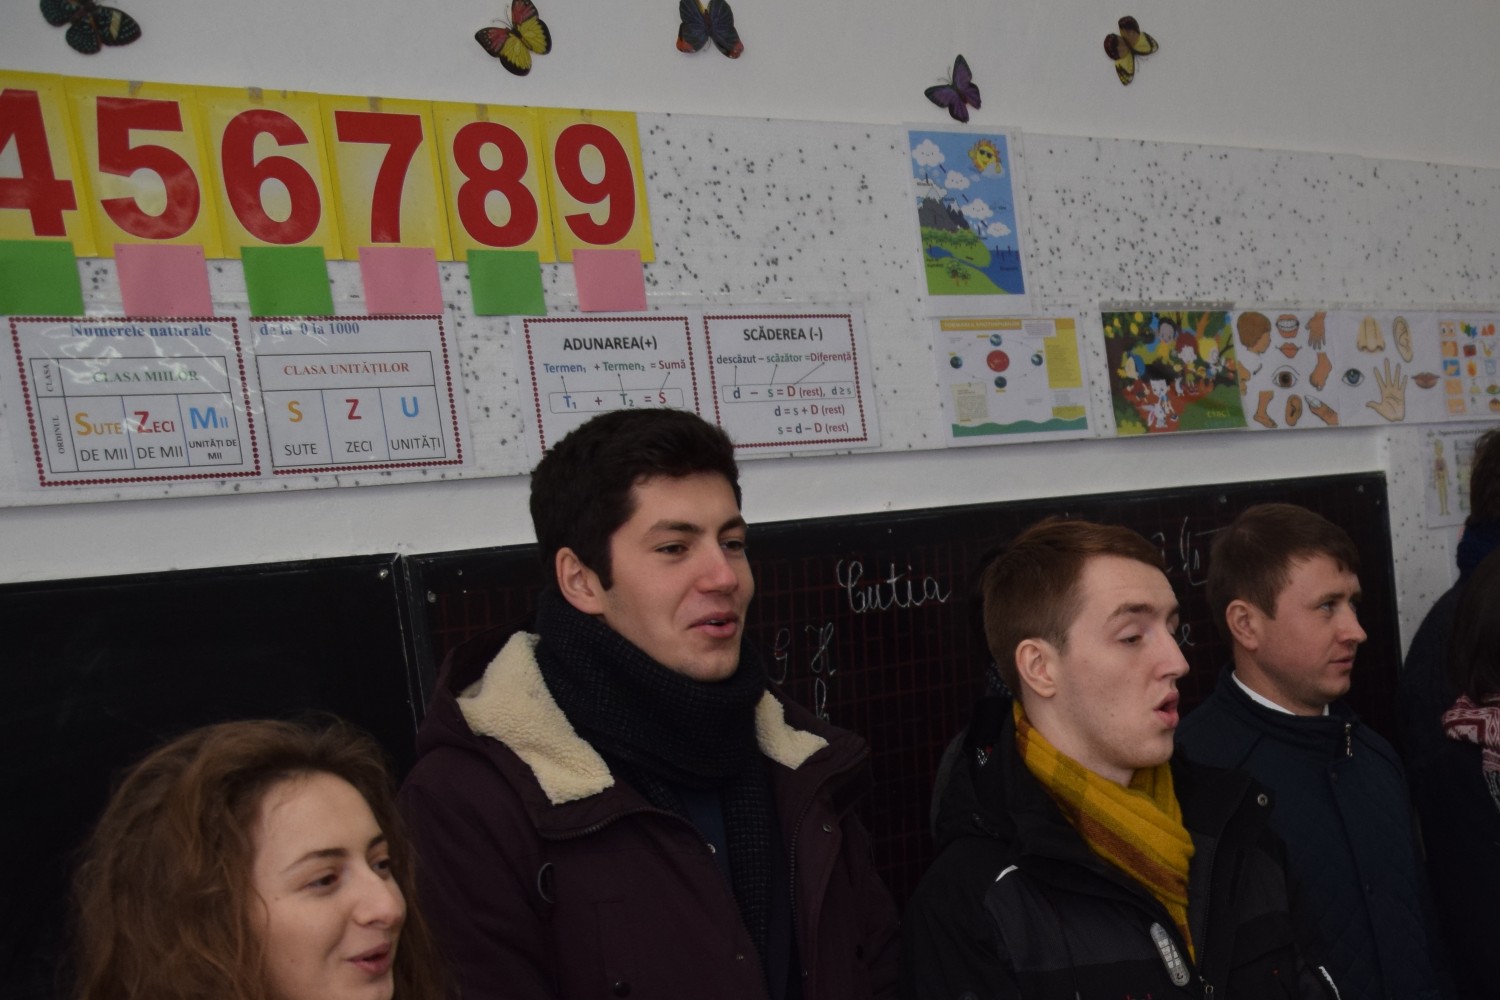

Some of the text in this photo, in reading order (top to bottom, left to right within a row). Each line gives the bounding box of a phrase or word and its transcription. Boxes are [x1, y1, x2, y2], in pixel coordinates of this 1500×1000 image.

[0, 89, 636, 248] 4 5 6 7 8 9
[71, 324, 212, 337] Numerele naturale
[330, 322, 360, 335] 1000
[743, 325, 807, 341] SCĂDEREA
[563, 336, 657, 351] ADUNAREA(+)
[658, 359, 686, 370] Sumă
[716, 354, 756, 365] descăzut
[766, 353, 802, 363] scăzător
[284, 364, 326, 376] CLASA
[93, 371, 140, 383] CLASA
[787, 386, 796, 397] D
[659, 392, 666, 404] S
[288, 400, 303, 423] S
[345, 398, 362, 420] Z
[401, 396, 419, 418] U
[811, 405, 819, 415] D
[814, 422, 822, 433] D
[226, 439, 237, 448] DE
[346, 441, 373, 453] ZECI
[80, 448, 128, 462] DE MII
[137, 446, 183, 460] DE MII
[285, 444, 318, 456] SUTE
[207, 452, 222, 461] MII
[836, 560, 952, 613] Cutia
